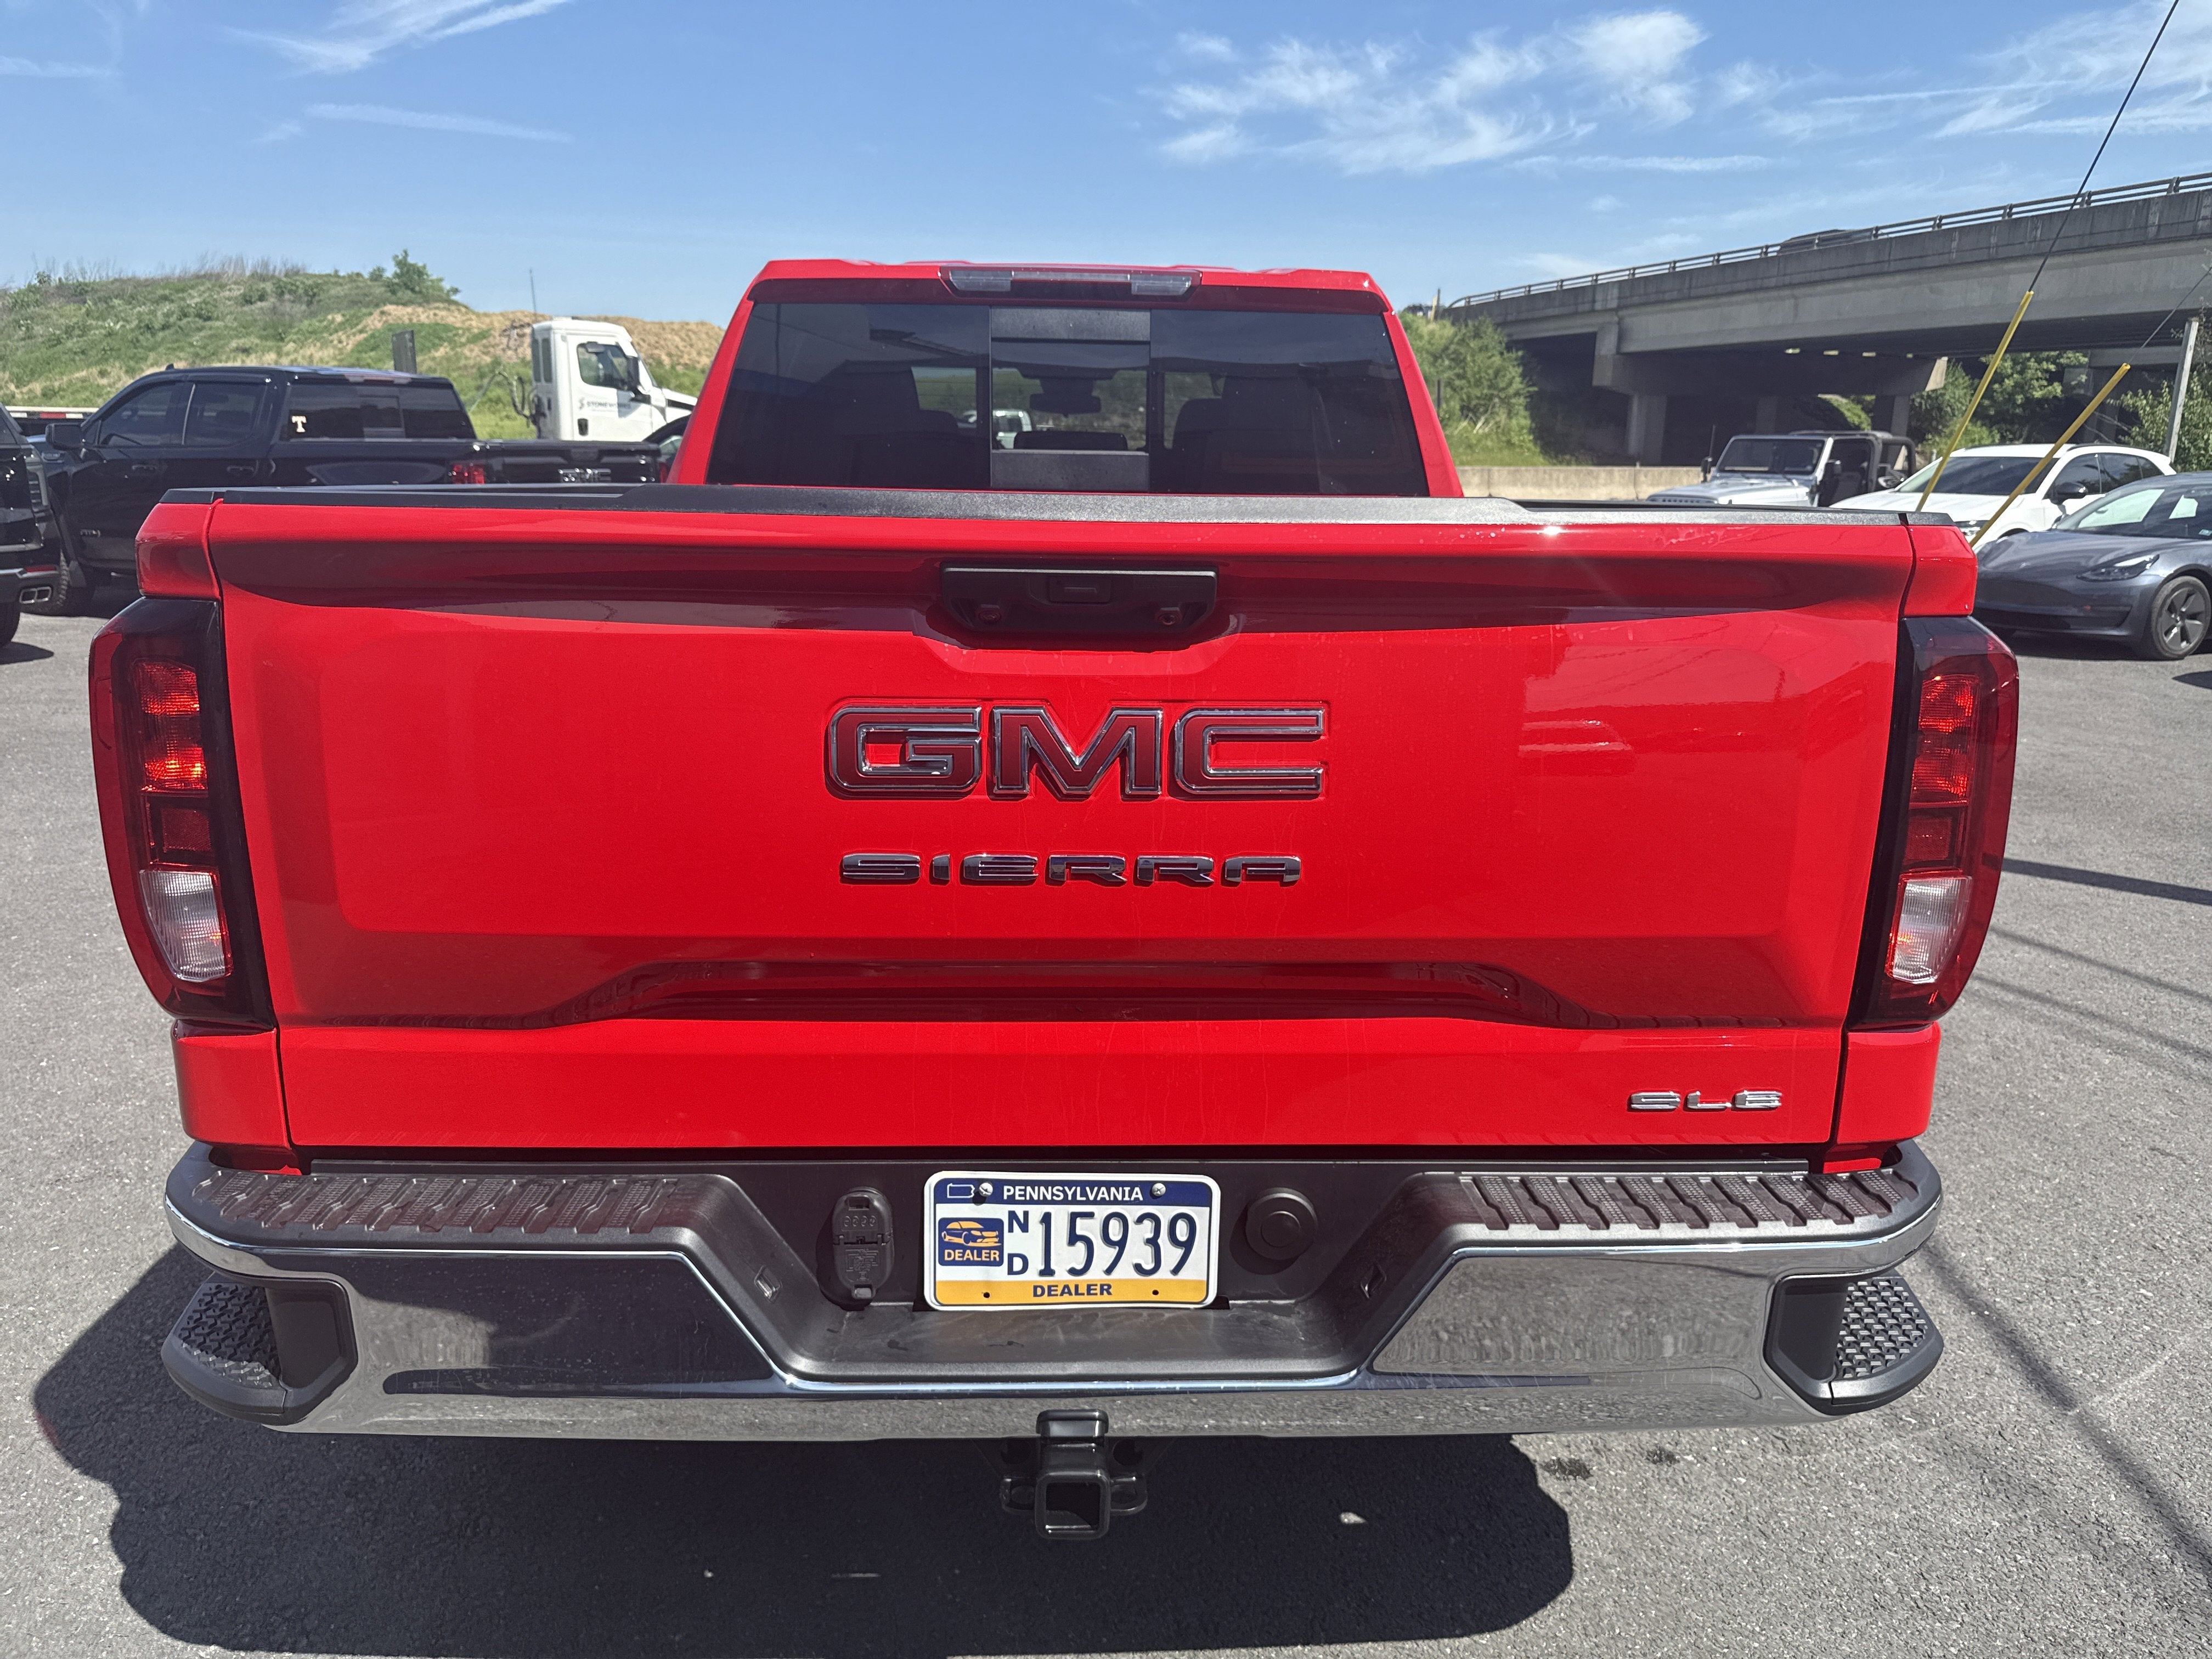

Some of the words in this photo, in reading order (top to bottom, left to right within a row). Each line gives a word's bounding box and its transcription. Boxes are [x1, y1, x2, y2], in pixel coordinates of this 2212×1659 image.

[292, 416, 307, 433] T
[827, 705, 1325, 797] GMC
[842, 853, 1302, 883] SIERRA
[1628, 1090, 1783, 1110] SLE
[1003, 1186, 1143, 1201] PENNSYLVANIA
[1039, 1211, 1198, 1276] 15939
[944, 1250, 1000, 1262] DEALER
[1032, 1283, 1113, 1297] DEALER
